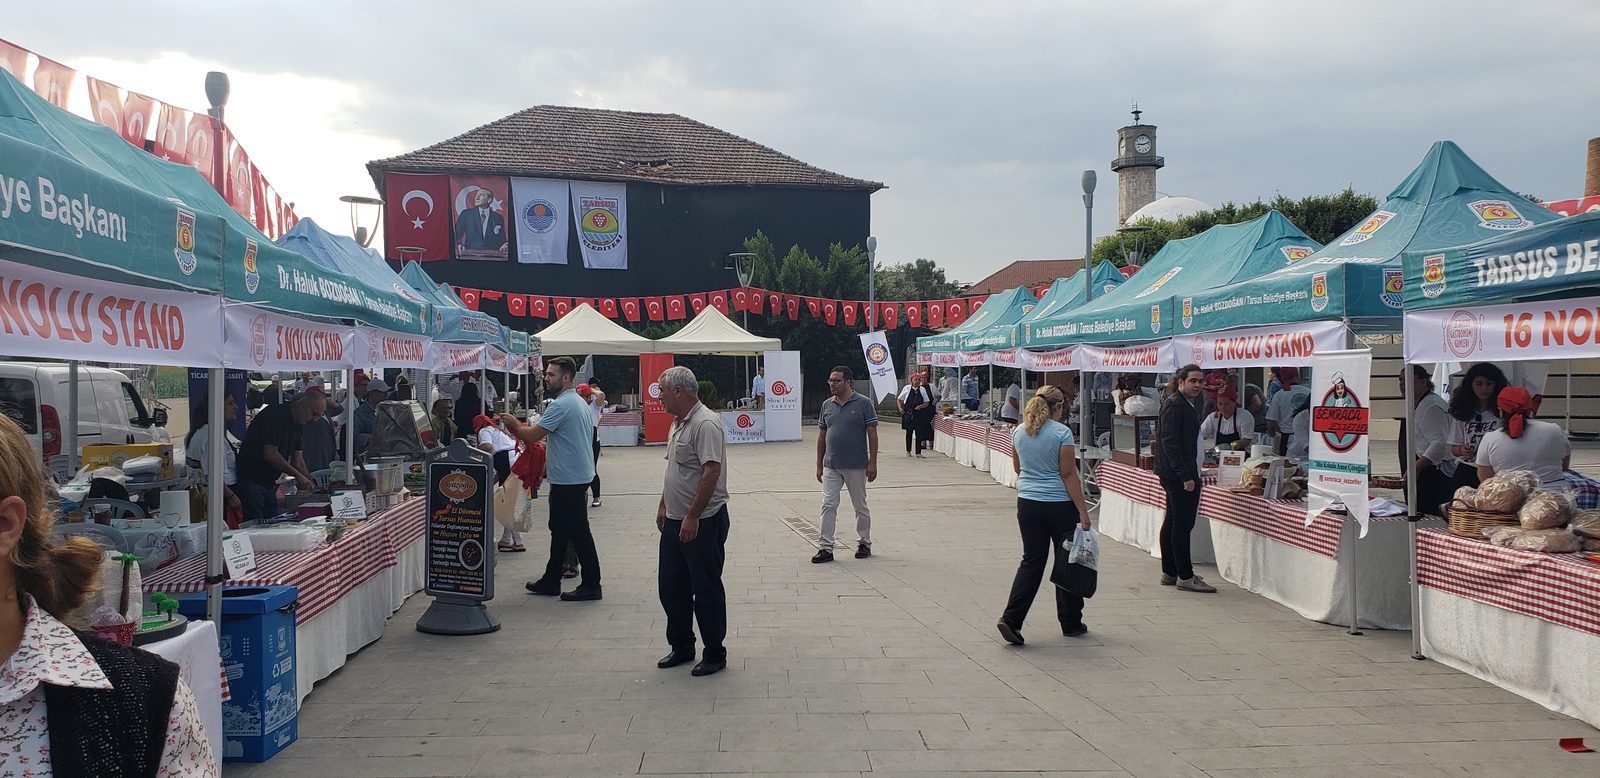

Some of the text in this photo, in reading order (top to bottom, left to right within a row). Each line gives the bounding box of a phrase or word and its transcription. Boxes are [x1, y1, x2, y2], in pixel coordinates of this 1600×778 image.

[38, 176, 128, 243] Başkanı
[583, 200, 616, 208] TARSUS
[1474, 246, 1562, 287] TARSUS
[277, 264, 293, 291] Dr.
[293, 268, 320, 297] Haluk
[318, 276, 361, 306] BOZDOĞAN
[1215, 296, 1244, 311] BOZDOĞAN
[1246, 295, 1264, 306] Tarsus
[1263, 291, 1285, 305] Belediye
[1285, 289, 1308, 303] Başkanı
[98, 295, 185, 351] STAND
[1080, 321, 1094, 335] Tarsus
[1094, 318, 1115, 336] Belediye
[1115, 317, 1136, 335] Başkanı
[1503, 306, 1600, 348] 16 NO
[276, 325, 284, 360] 3
[285, 327, 313, 361] NOLU
[314, 331, 343, 361] STAND
[387, 336, 405, 361] NOLU
[404, 338, 424, 362] STAND
[1102, 346, 1159, 367] 14 NOLU STAND
[1213, 338, 1225, 360] 15
[1226, 336, 1264, 360] NOLU
[1264, 332, 1315, 359] STAND
[1316, 408, 1361, 421] SEMRACA
[728, 428, 762, 437] Slow Food
